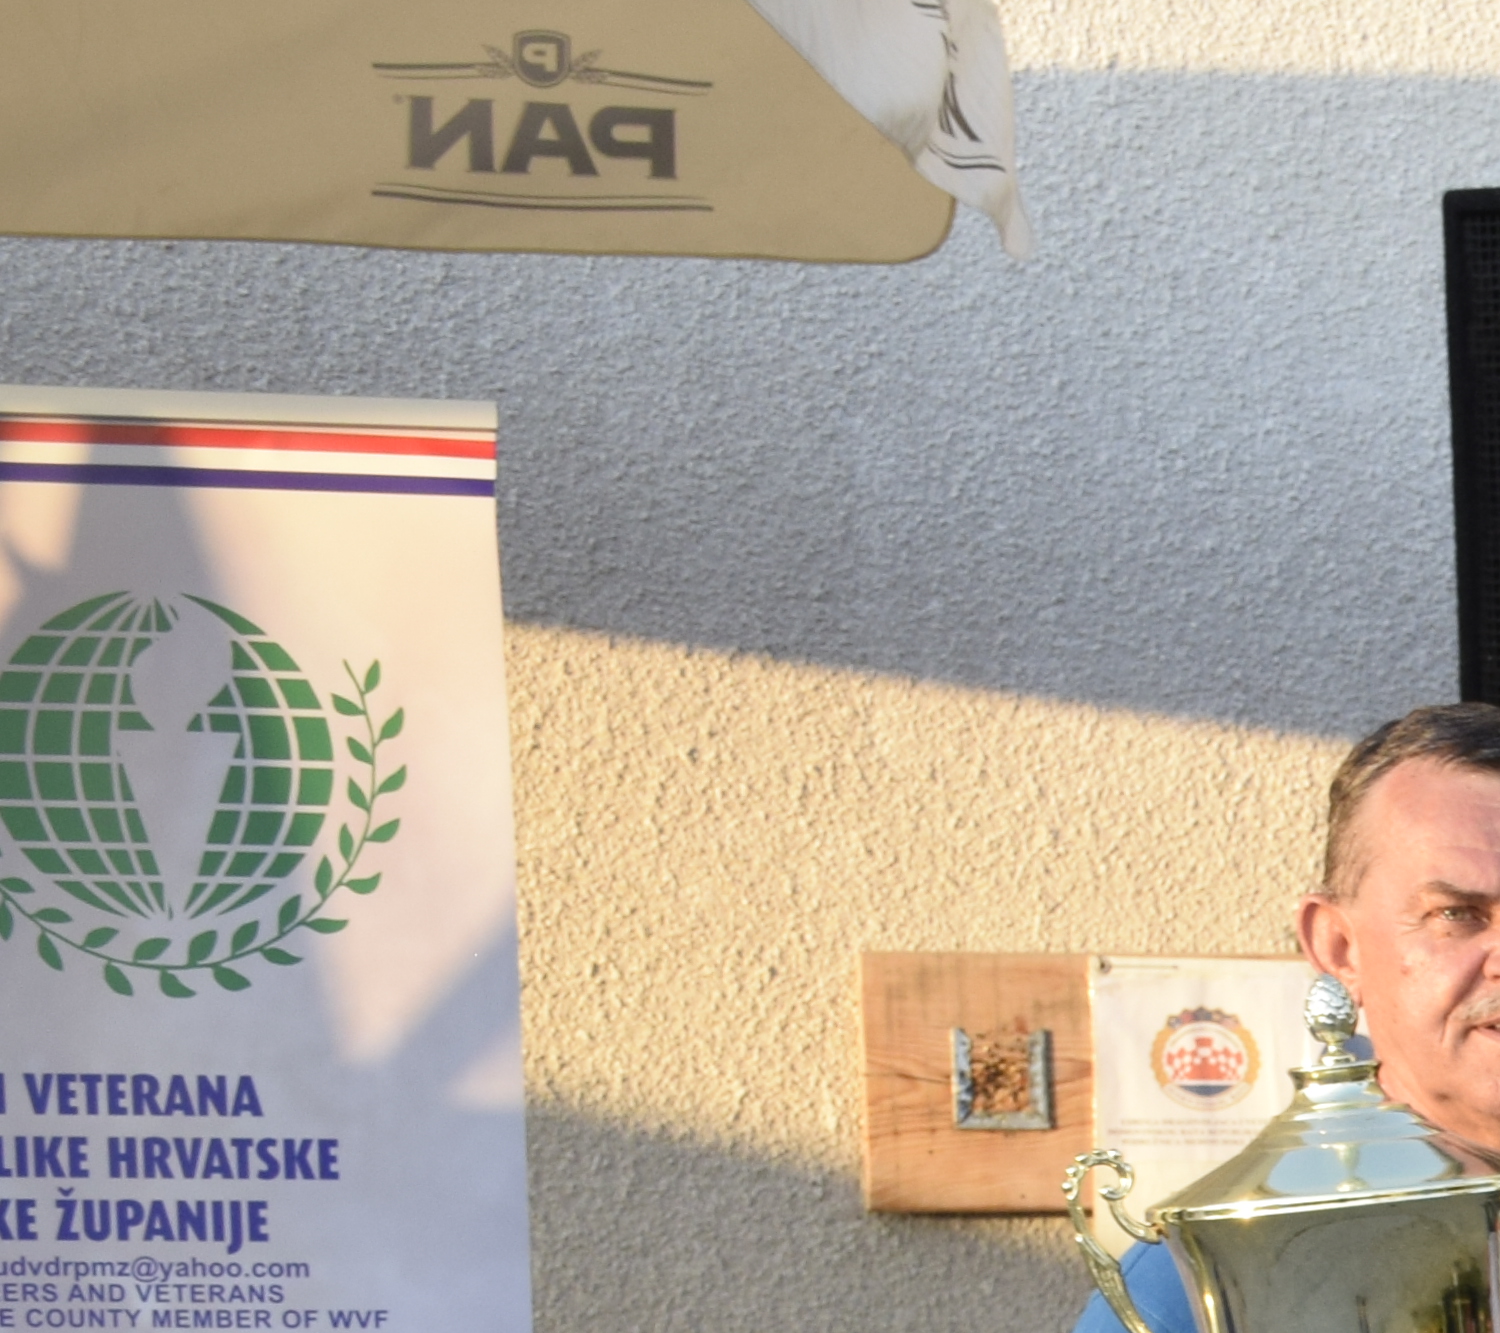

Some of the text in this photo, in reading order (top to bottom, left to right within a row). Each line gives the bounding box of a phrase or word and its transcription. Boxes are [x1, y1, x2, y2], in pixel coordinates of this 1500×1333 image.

[23, 1073, 264, 1117] VETERANA
[108, 1137, 340, 1180] HRVATSKE
[56, 1187, 270, 1255] ŽUPANIJE
[68, 1283, 126, 1303] AND
[135, 1284, 286, 1304] VETERANS
[25, 1309, 141, 1329] COUNTY
[152, 1309, 272, 1329] MEMBER
[281, 1309, 318, 1329] OF
[328, 1309, 389, 1329] WVF
